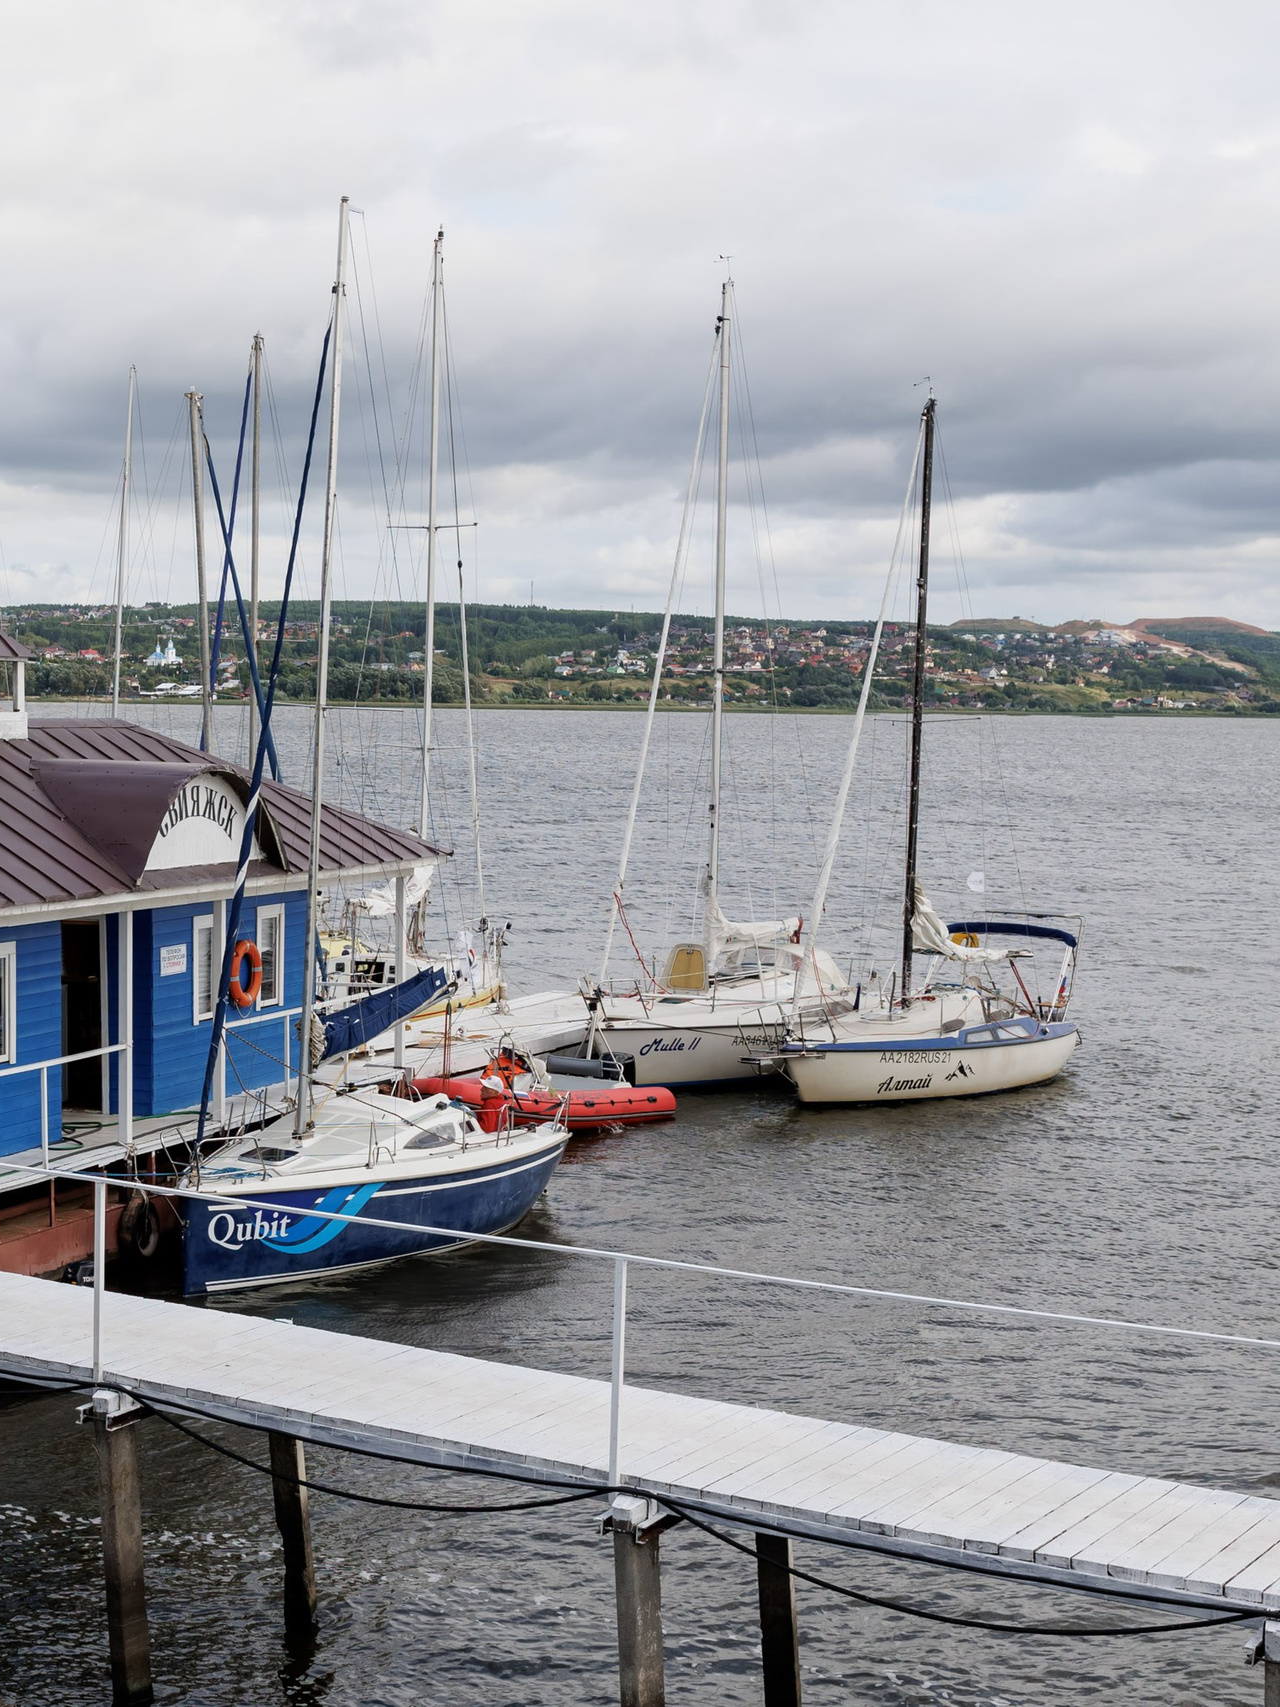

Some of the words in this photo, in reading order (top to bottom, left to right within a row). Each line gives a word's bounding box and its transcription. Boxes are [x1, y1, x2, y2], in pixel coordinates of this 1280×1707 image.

[639, 1037, 685, 1056] Mulle
[877, 1073, 934, 1094] Алтай
[208, 1210, 291, 1251] Qubit
